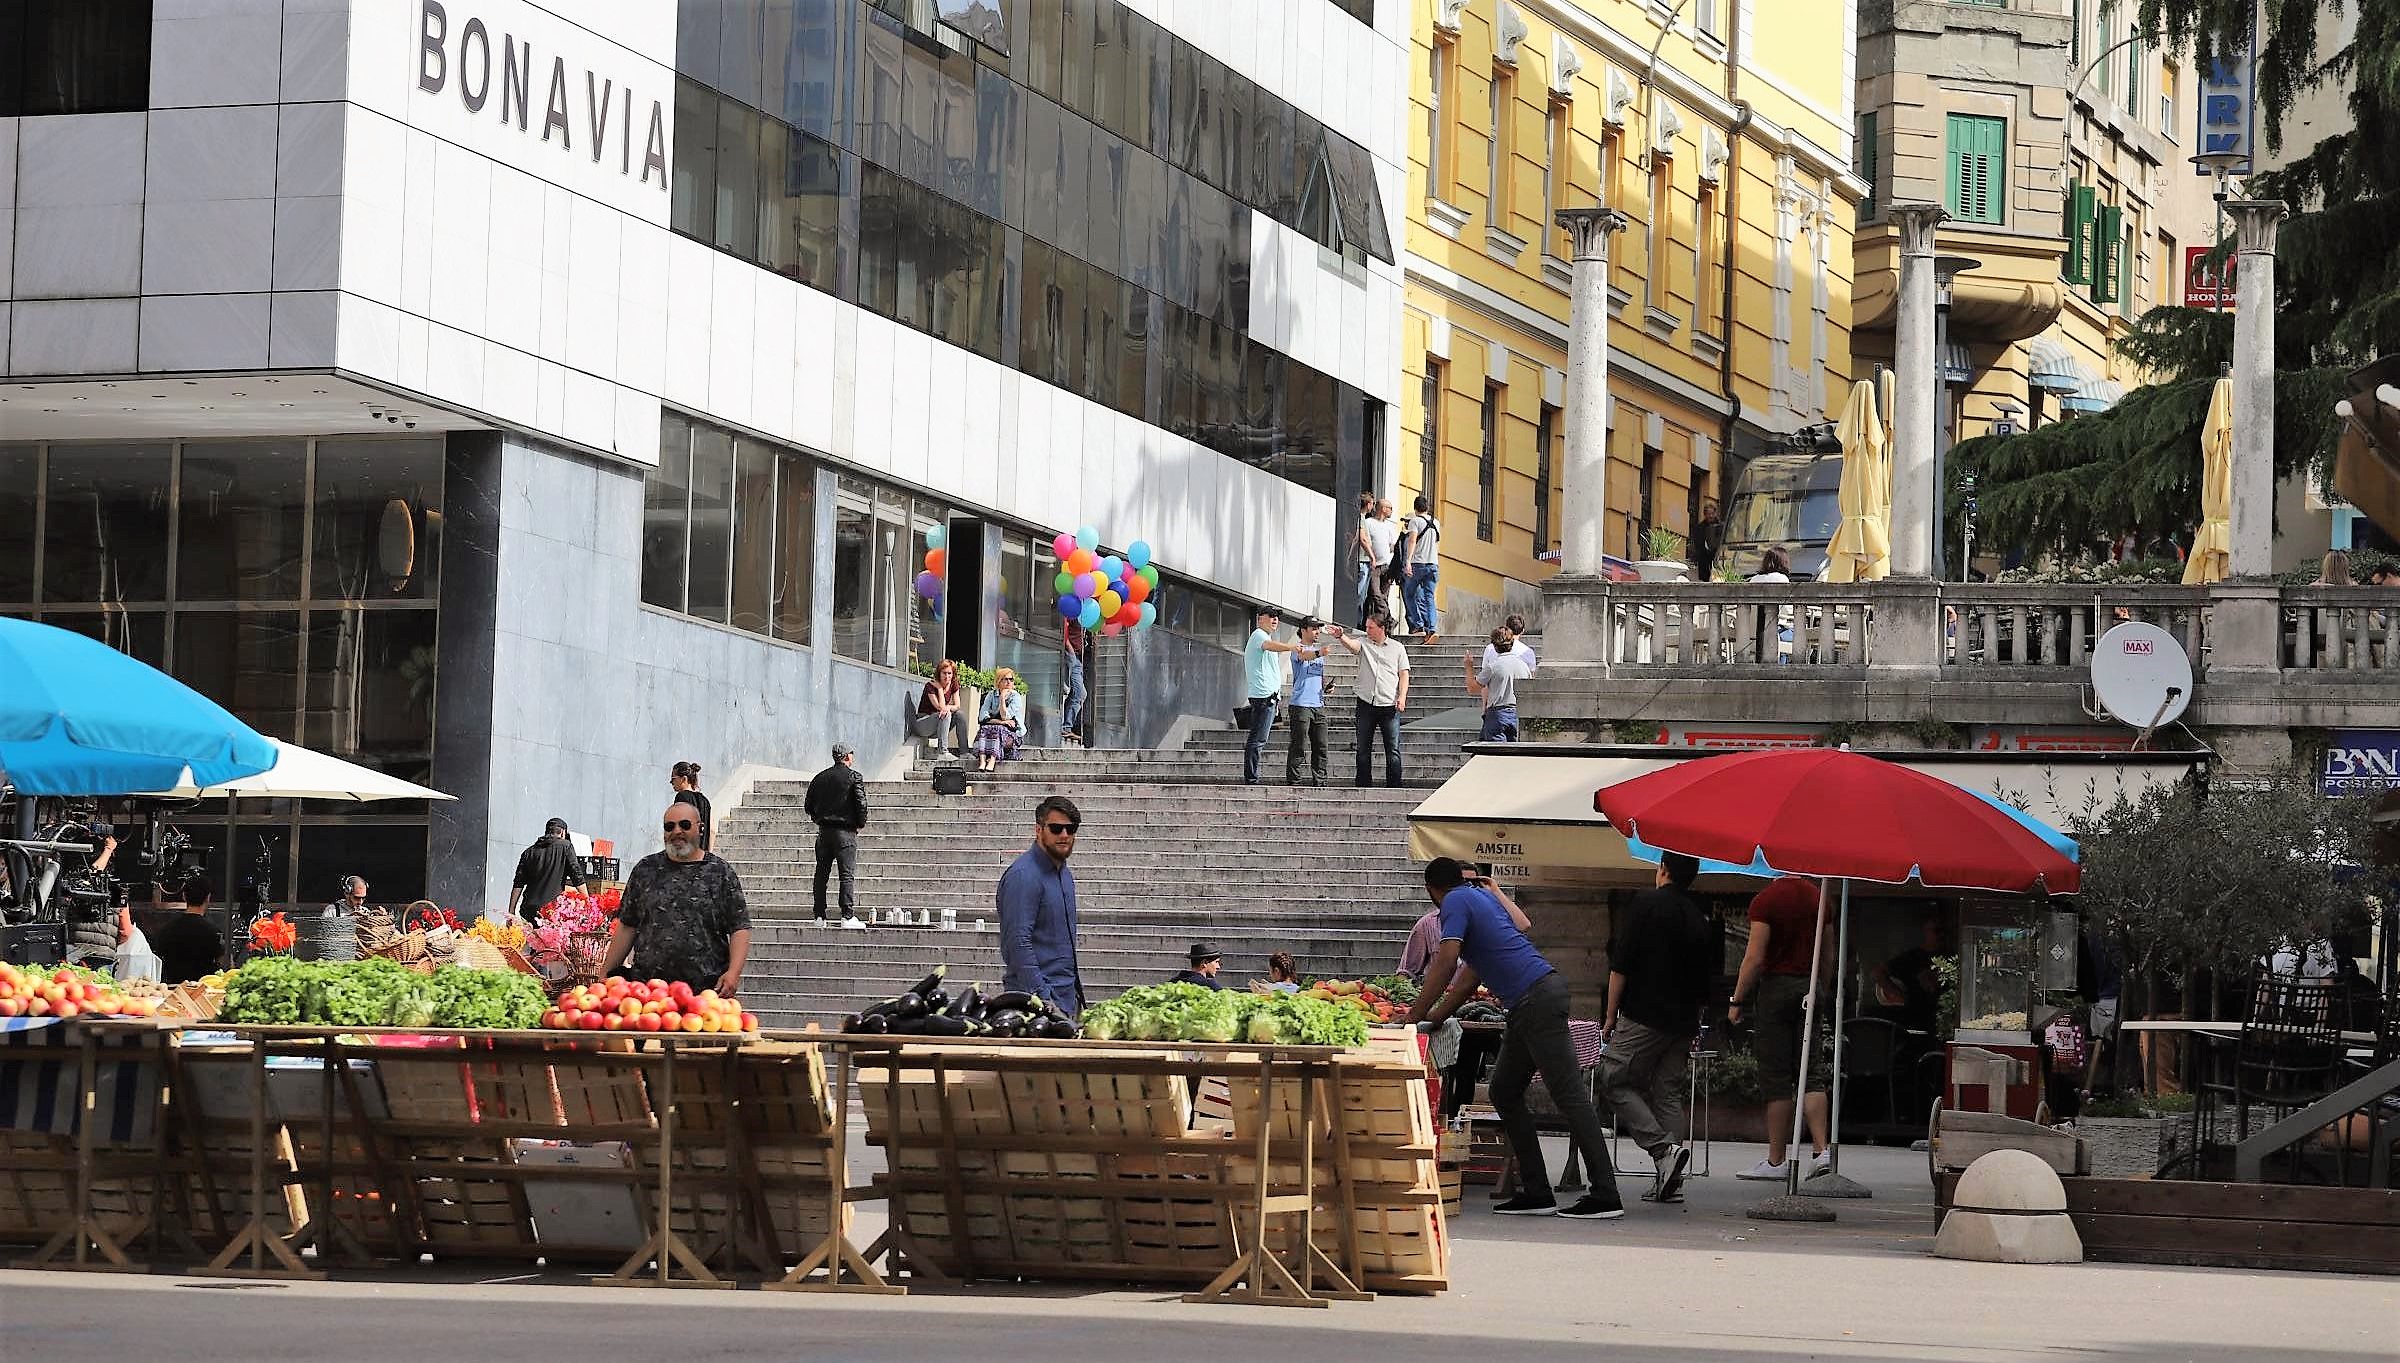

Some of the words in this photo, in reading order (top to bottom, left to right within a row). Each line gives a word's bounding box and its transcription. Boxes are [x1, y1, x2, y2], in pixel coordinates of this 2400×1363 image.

[418, 0, 668, 190] BONAVIA
[2126, 642, 2150, 652] MAX
[1475, 843, 1525, 854] AMSTEL
[1493, 865, 1530, 877] MSTEL
